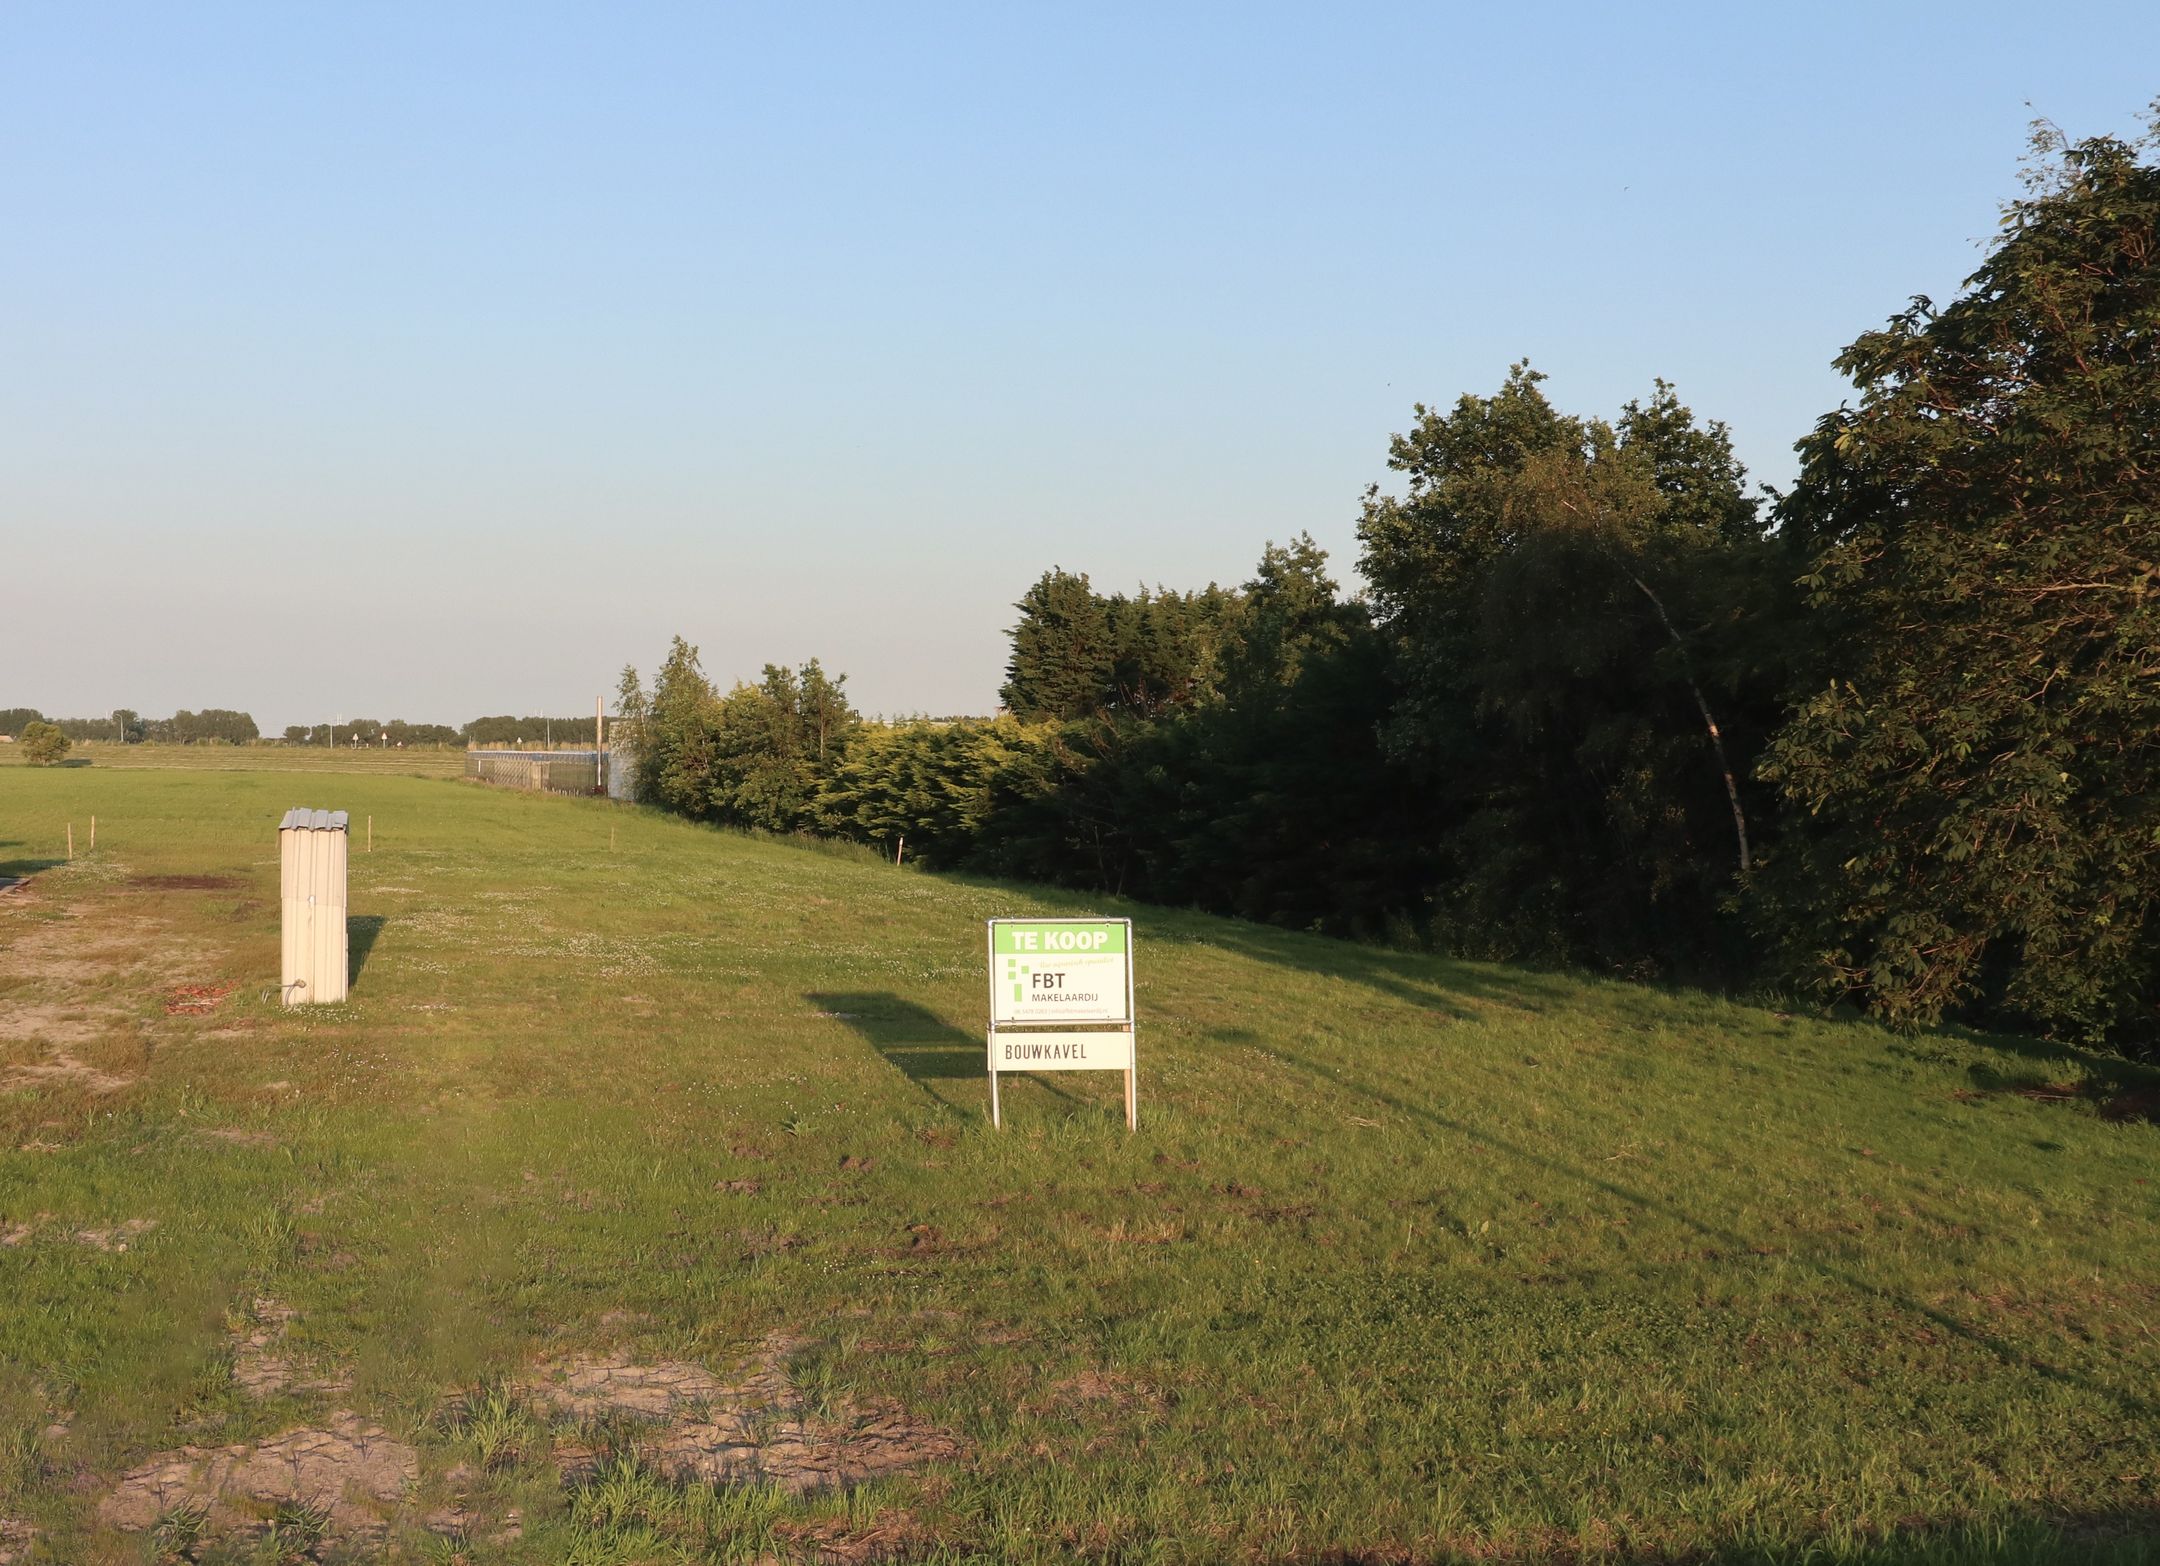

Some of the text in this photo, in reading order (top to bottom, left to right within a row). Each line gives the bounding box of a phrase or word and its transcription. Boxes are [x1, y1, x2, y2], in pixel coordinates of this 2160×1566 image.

[1011, 931, 1109, 950] TE KOOP
[1032, 973, 1066, 989] FBT
[1031, 993, 1099, 1002] MAKELAARDIJ
[1005, 1043, 1087, 1060] BOUWKAVEL
